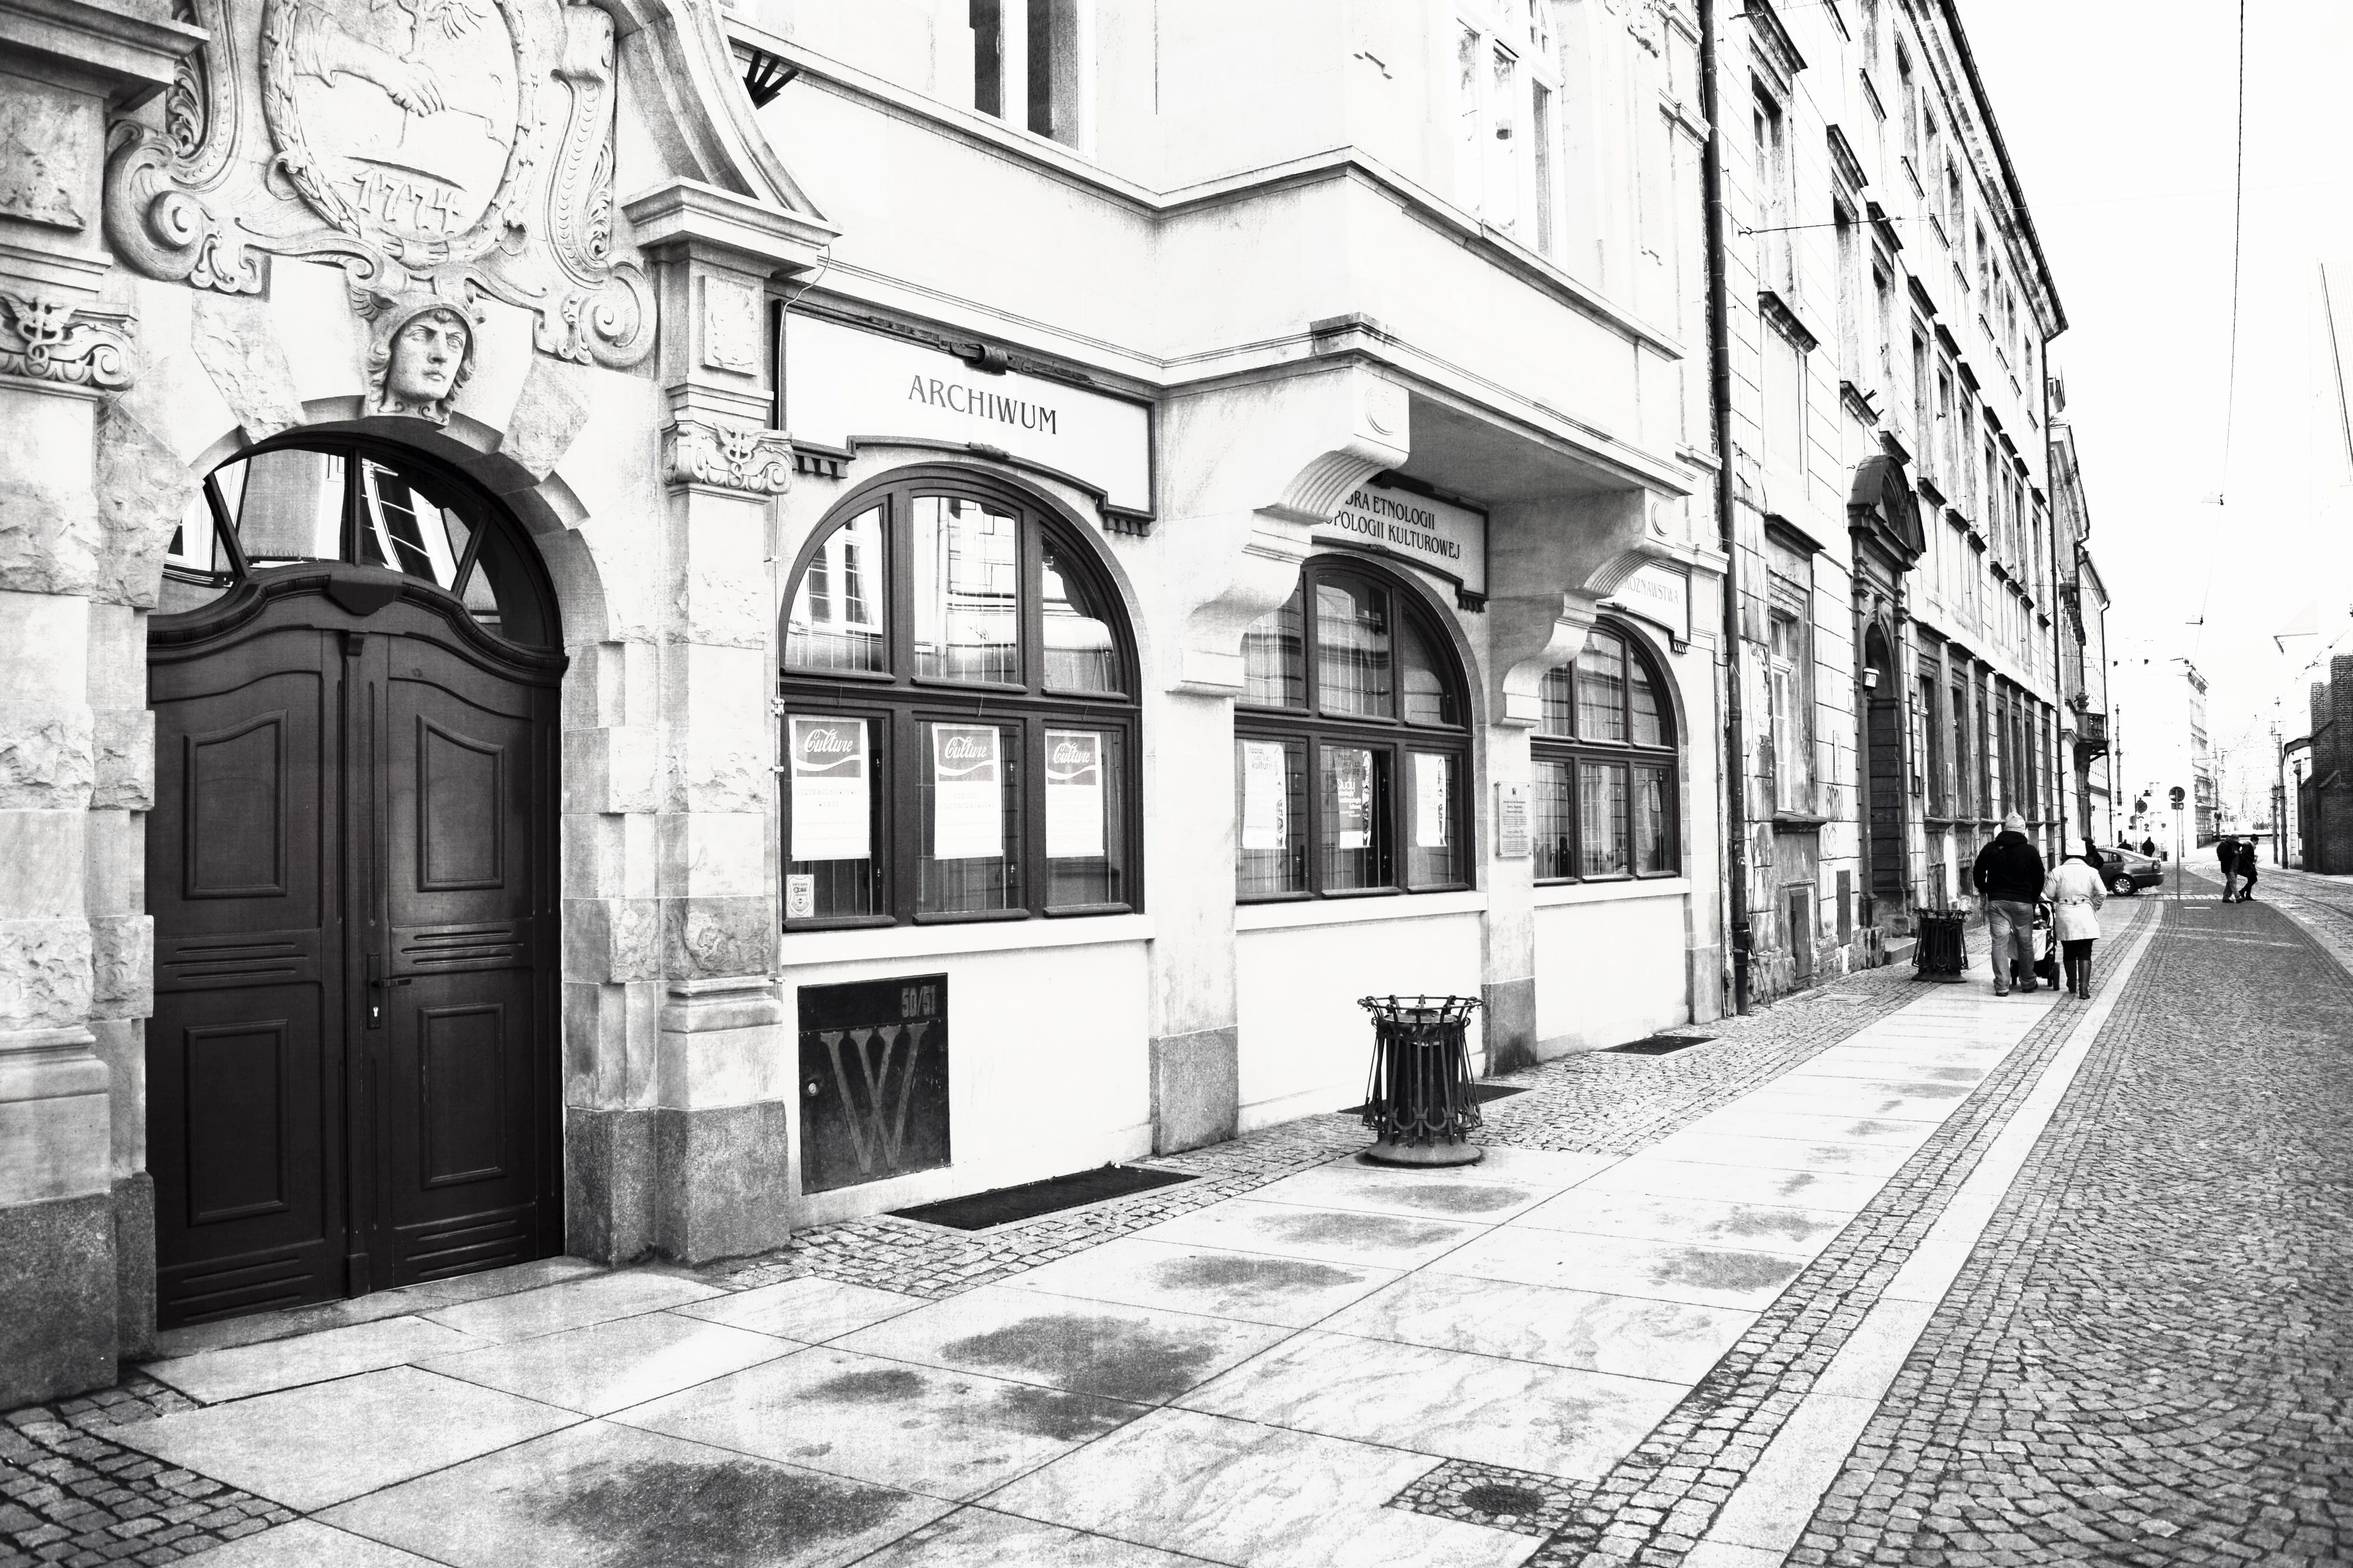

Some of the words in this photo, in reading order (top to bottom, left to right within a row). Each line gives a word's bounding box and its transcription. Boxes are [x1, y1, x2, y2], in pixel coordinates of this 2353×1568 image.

[352, 168, 461, 233] 1774
[908, 374, 1058, 436] ARCHIWUM
[1374, 496, 1435, 530] ETNOLOGII
[1326, 511, 1384, 539] POLOGII
[1389, 524, 1460, 559] KULTUROWEJ
[1624, 576, 1679, 605] ROZNAWSTWA
[804, 728, 853, 753] Culture
[944, 736, 987, 759] Culture
[1053, 742, 1091, 764] Culture
[901, 985, 937, 1017] 50/51
